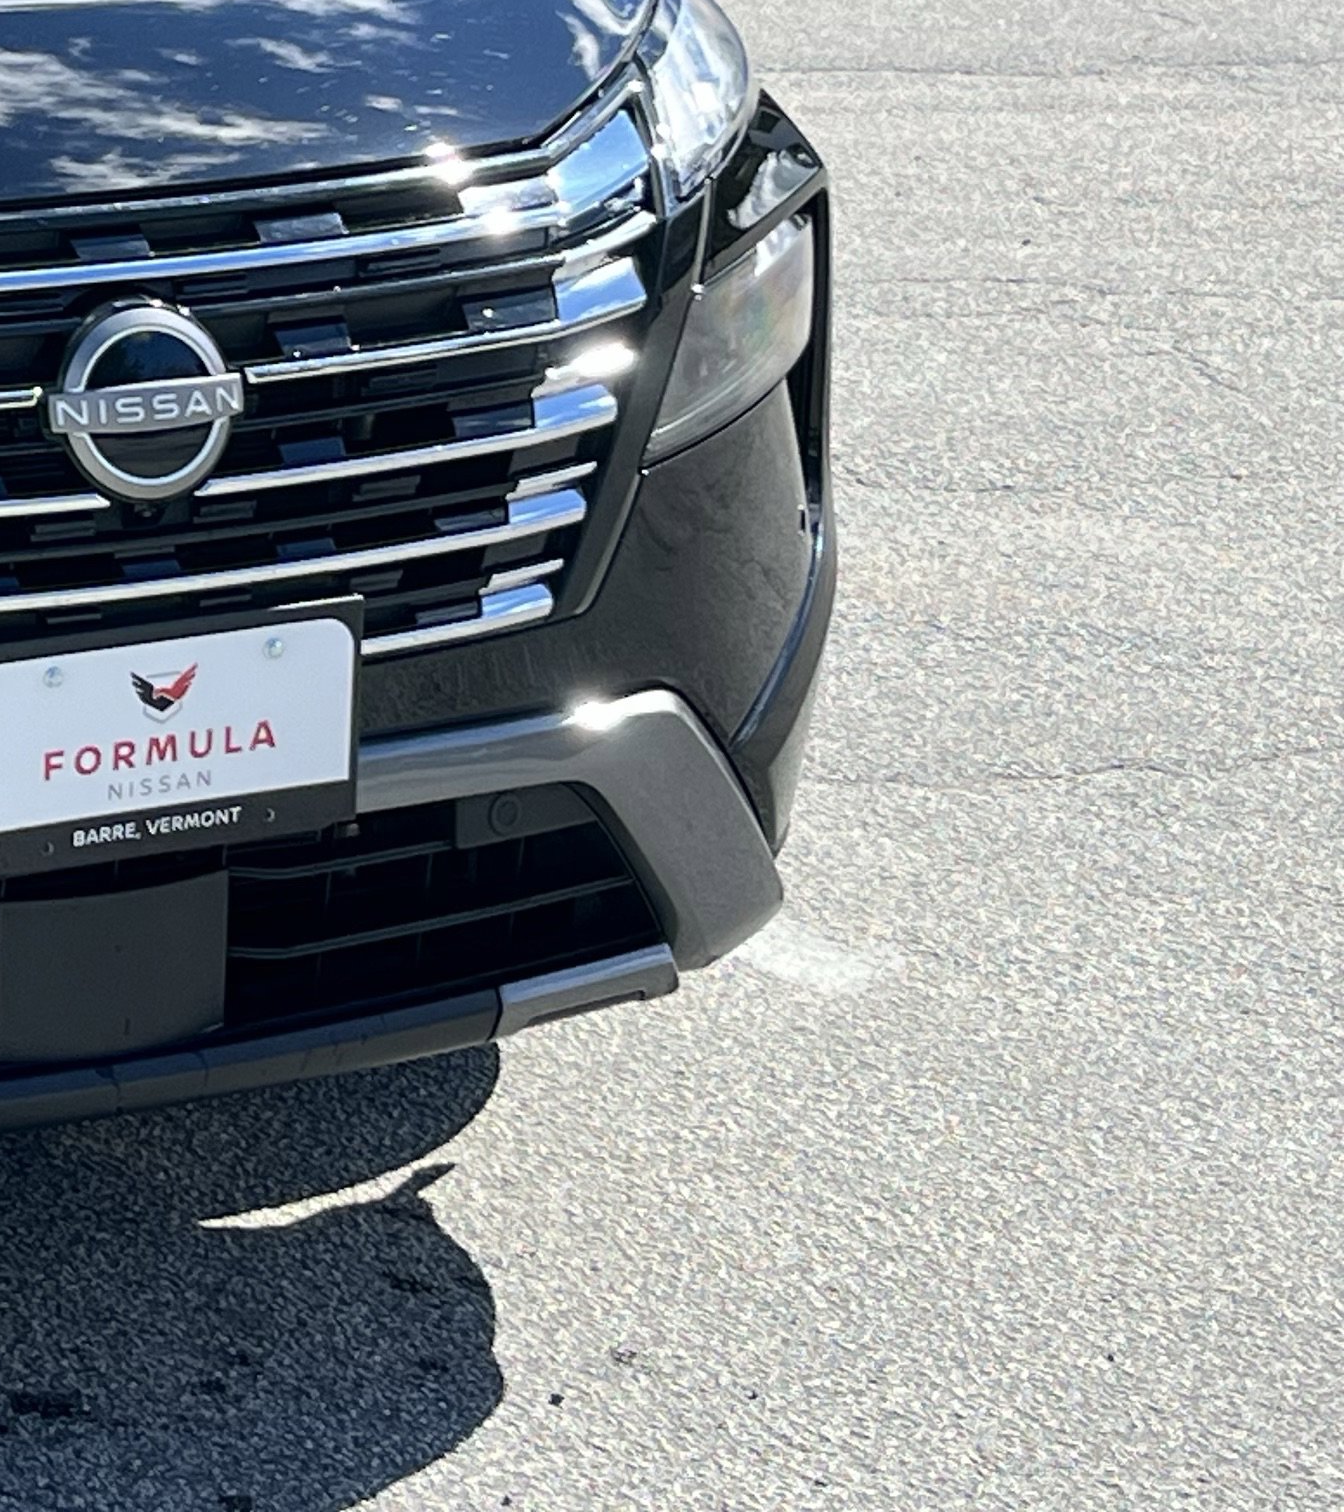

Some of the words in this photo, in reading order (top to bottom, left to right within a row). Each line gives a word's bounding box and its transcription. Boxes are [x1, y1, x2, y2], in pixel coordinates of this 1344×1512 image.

[54, 384, 241, 426] NISSAN
[42, 719, 277, 781] FORMULA
[107, 769, 213, 801] NISSAN
[72, 821, 142, 848] BARRE,
[145, 805, 243, 836] VERMONT
